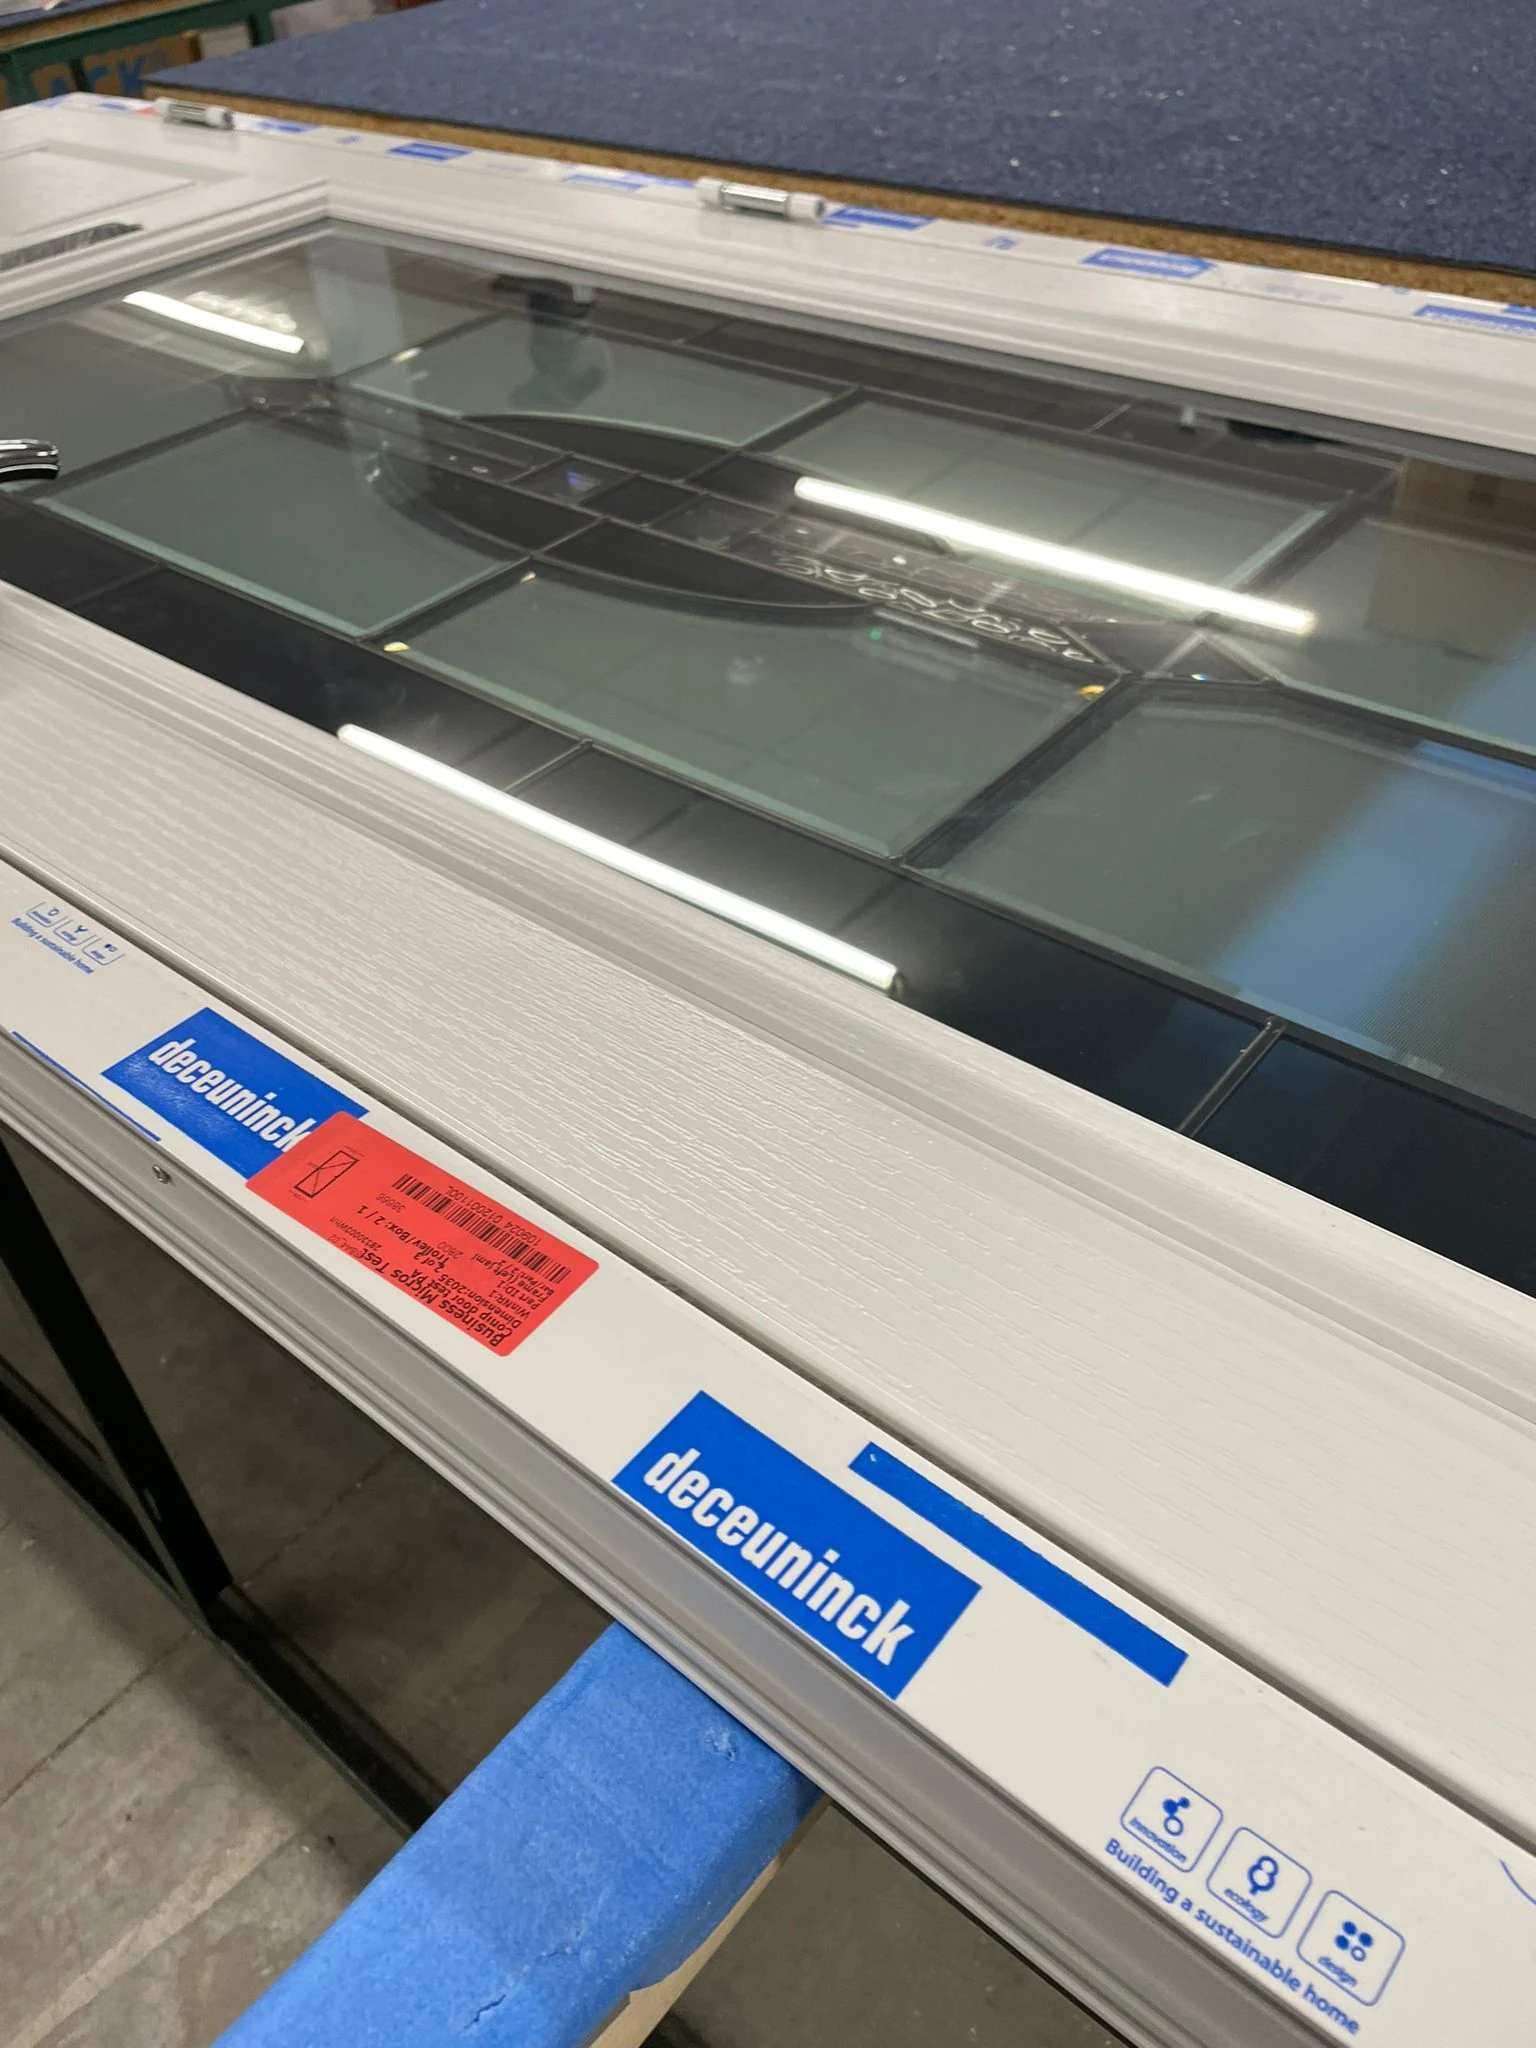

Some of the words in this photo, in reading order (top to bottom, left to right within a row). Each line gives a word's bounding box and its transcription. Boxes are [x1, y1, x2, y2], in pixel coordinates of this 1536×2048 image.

[148, 1038, 317, 1153] deceuninck
[356, 1205, 369, 1214] 1
[364, 1211, 379, 1219] /
[373, 1215, 386, 1226] 2
[504, 1221, 542, 1246] 109024
[354, 1248, 390, 1274] Test
[413, 1252, 425, 1261] 3
[420, 1258, 435, 1266] of
[433, 1263, 446, 1274] 2
[390, 1269, 439, 1304] Micros
[411, 1268, 429, 1283] PA
[426, 1279, 451, 1298] test
[518, 1281, 549, 1303] Frame
[438, 1274, 523, 1329] Dimension:2035
[447, 1295, 478, 1314] door
[488, 1289, 531, 1320] WinNR:1
[518, 1294, 541, 1310] Part
[438, 1300, 508, 1347] Business
[643, 1448, 914, 1666] deceuninck
[1129, 1816, 1188, 1864] innovation
[1224, 1887, 1269, 1923] ecology
[1105, 1838, 1180, 1904] Building
[1180, 1896, 1194, 1912] a
[1194, 1906, 1302, 1992] sustainable
[1303, 1984, 1360, 2036] home
[1317, 1955, 1358, 1988] design
